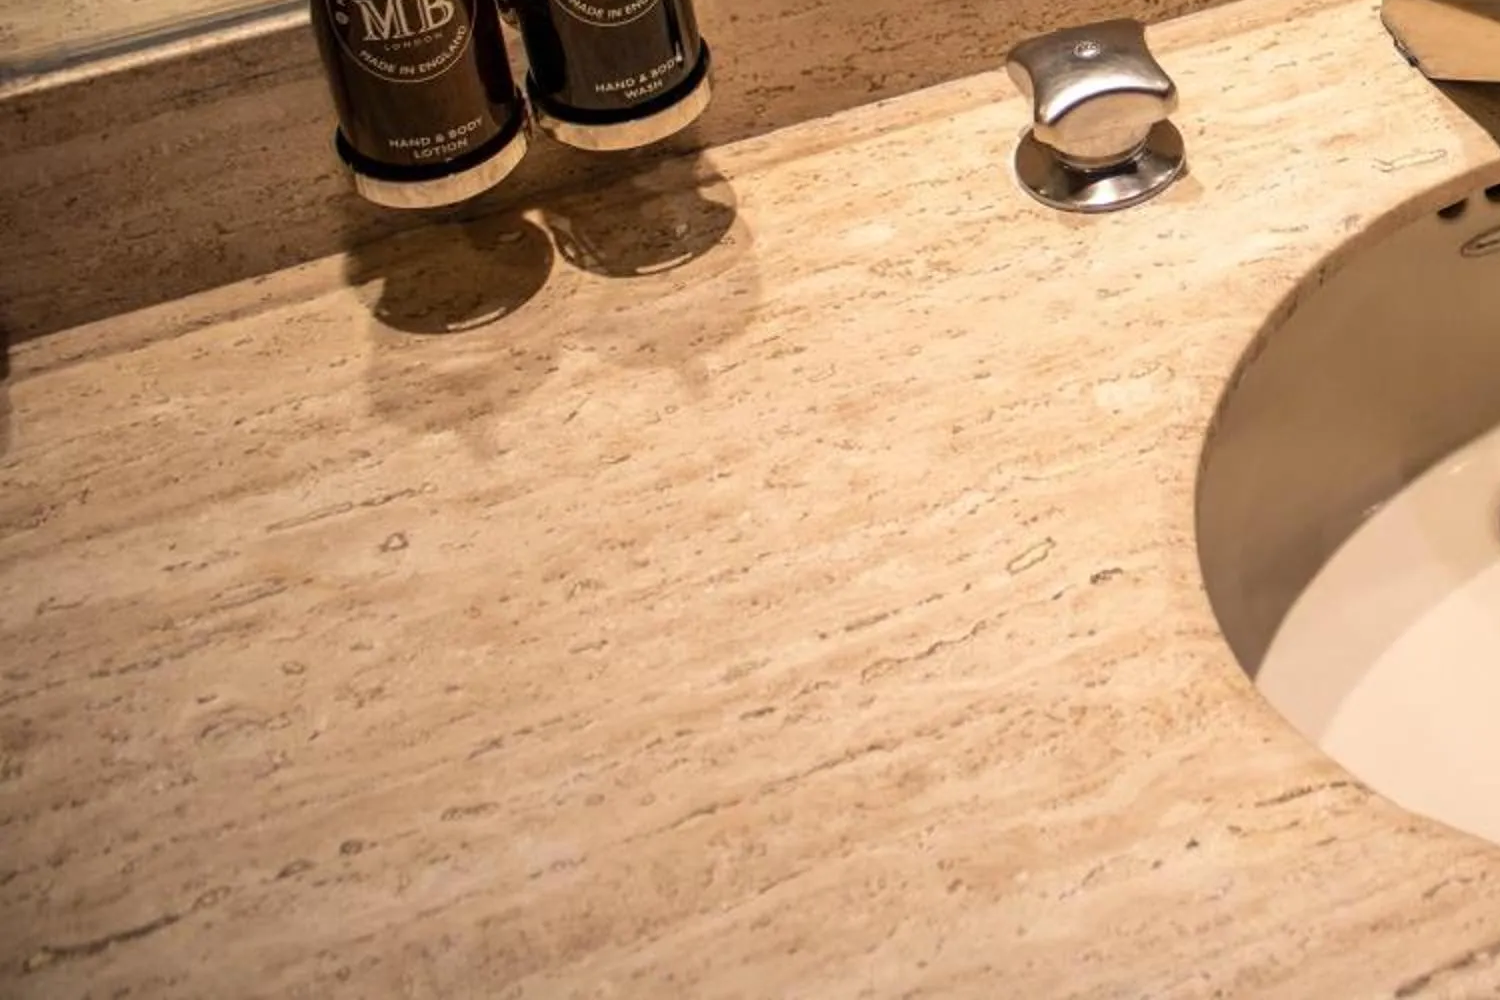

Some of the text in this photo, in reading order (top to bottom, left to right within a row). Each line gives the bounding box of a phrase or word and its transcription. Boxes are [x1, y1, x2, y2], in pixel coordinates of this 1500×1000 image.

[607, 7, 623, 18] IN
[359, 24, 467, 75] MADE IN ENGLAND
[595, 77, 635, 93] HAND
[388, 136, 431, 148] HAND
[413, 137, 468, 159] LOTION
